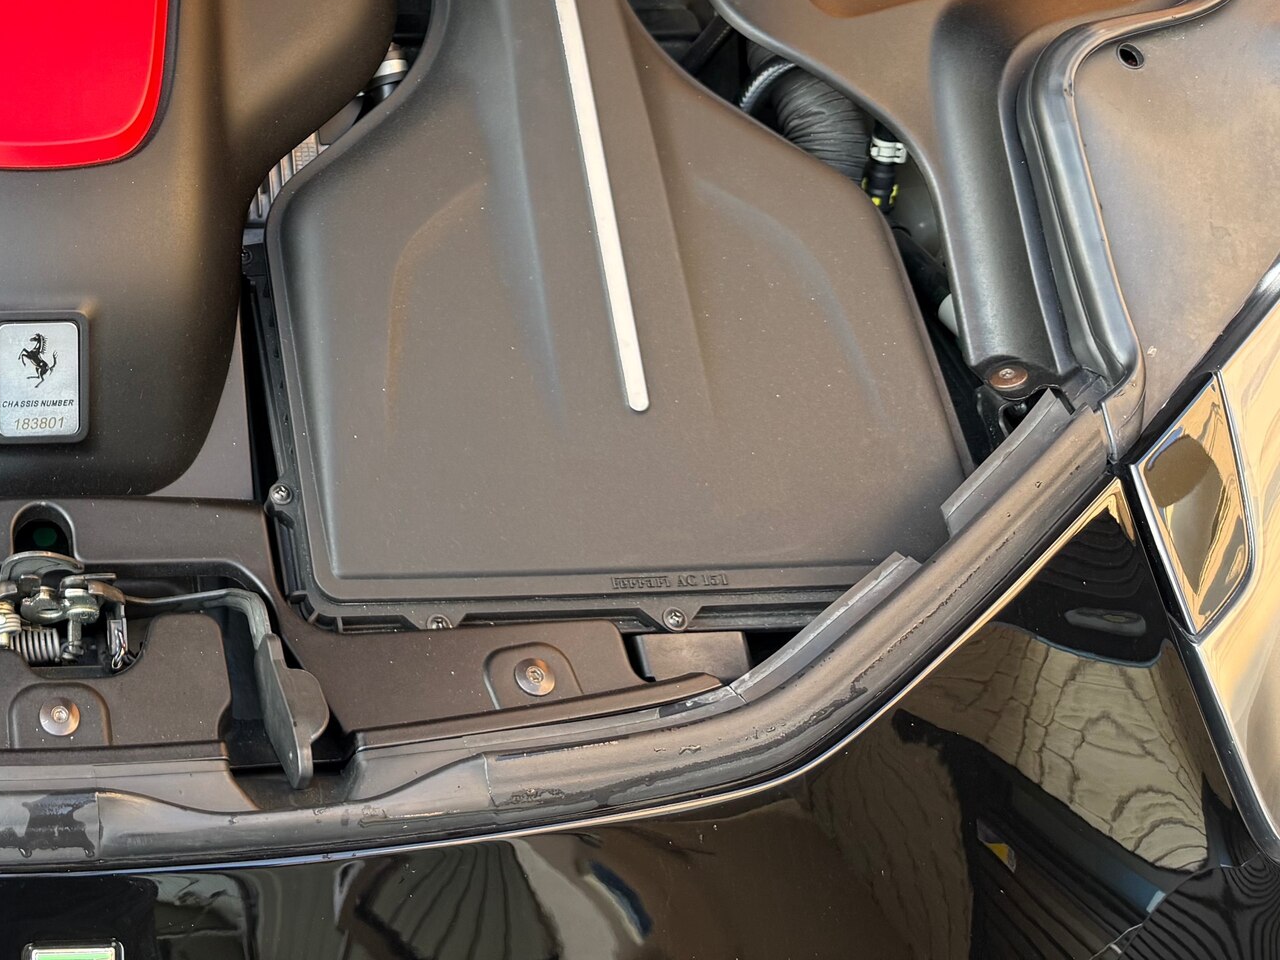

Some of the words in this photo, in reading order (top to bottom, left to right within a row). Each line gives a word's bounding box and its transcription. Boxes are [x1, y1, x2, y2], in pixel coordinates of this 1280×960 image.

[2, 400, 39, 408] CHASSIS
[40, 399, 74, 407] NUMBER
[14, 416, 65, 430] 183801
[611, 576, 671, 589] Ferrari
[677, 574, 696, 587] AC
[703, 573, 729, 586] 151
